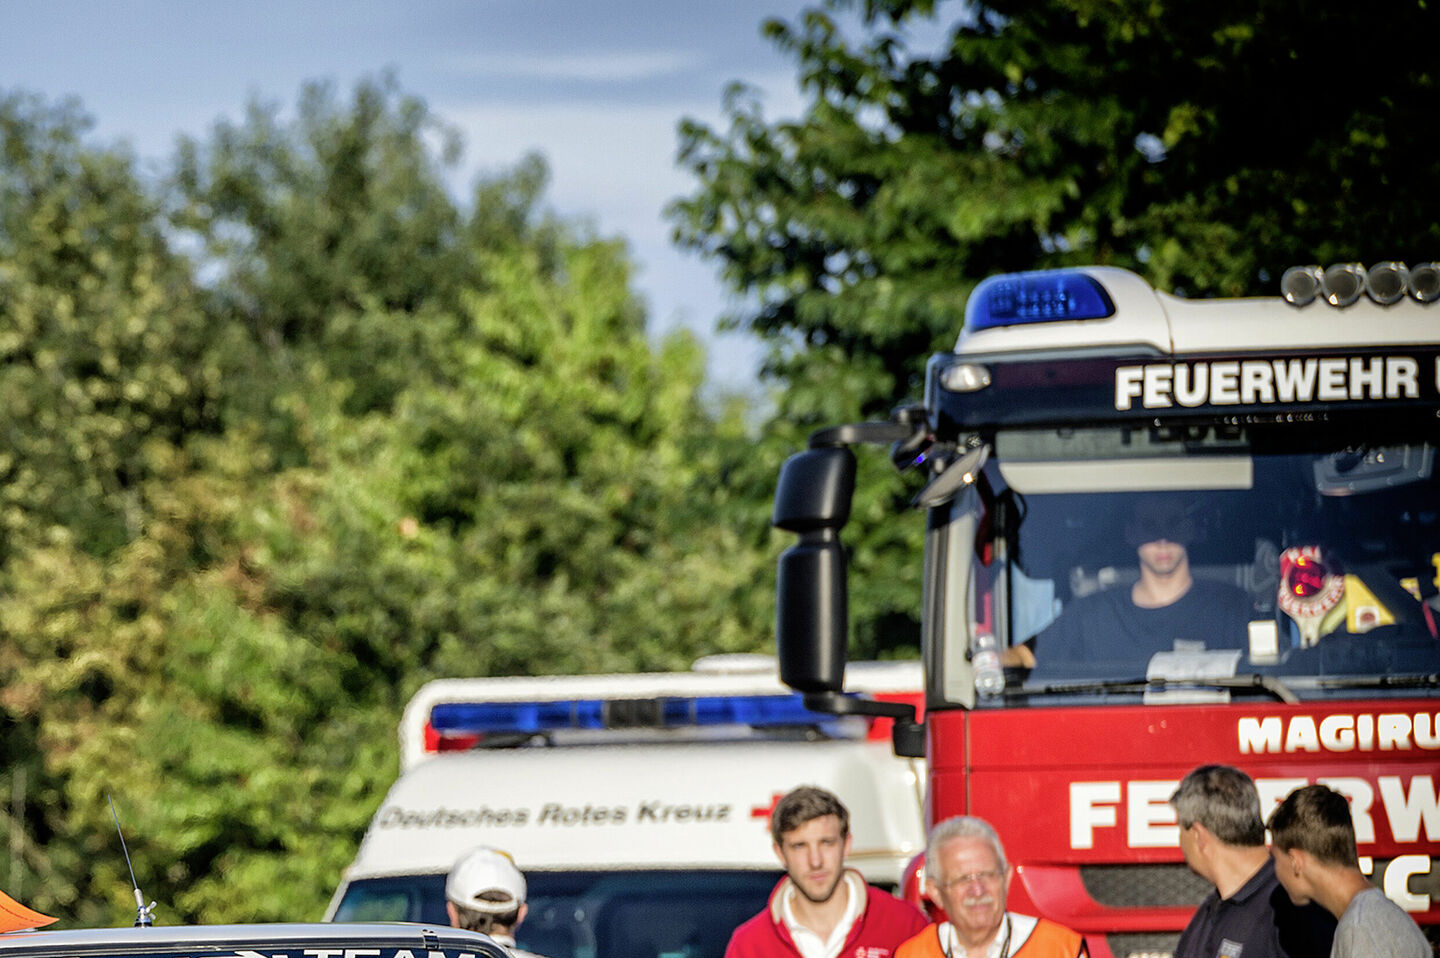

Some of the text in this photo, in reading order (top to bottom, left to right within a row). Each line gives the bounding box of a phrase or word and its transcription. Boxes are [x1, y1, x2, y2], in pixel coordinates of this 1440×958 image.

[1115, 356, 1419, 411] FEUERWEHR
[380, 800, 732, 829] Deutsches Rotes Kreuz
